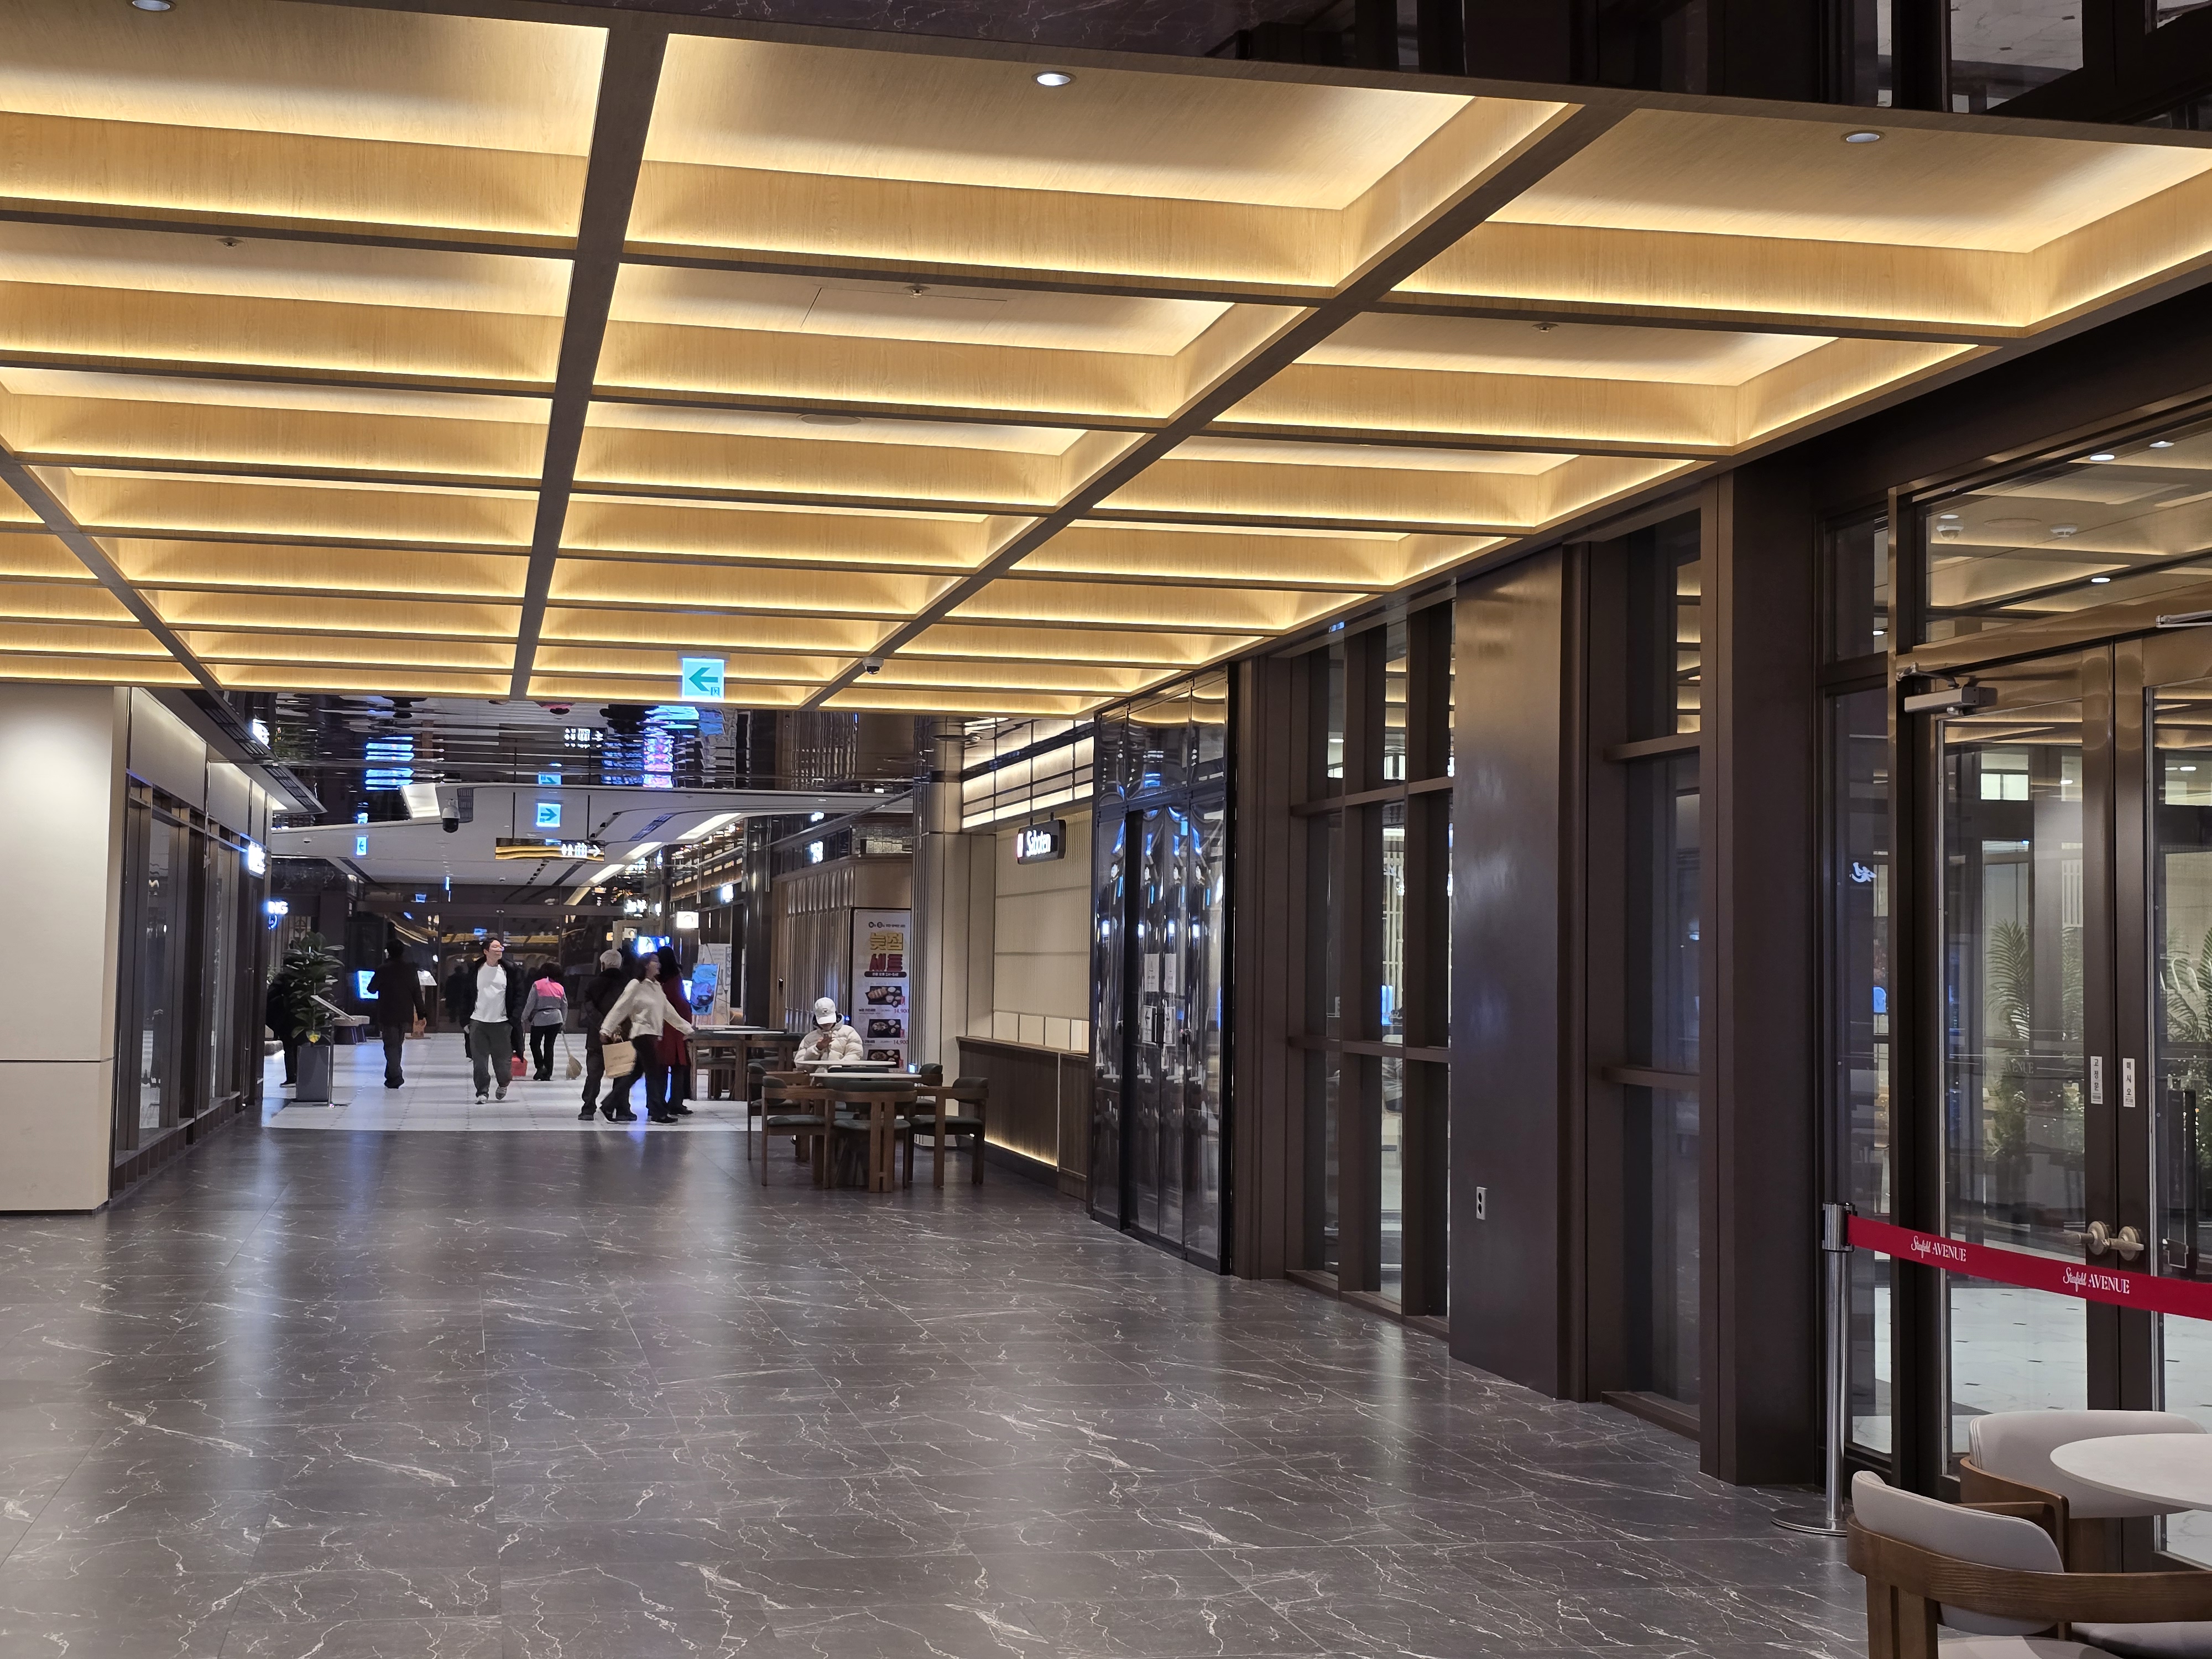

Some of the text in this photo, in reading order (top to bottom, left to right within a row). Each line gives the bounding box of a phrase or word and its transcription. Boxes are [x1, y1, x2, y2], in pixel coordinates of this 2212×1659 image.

[870, 932, 903, 950] 늦점
[869, 953, 903, 971] 세트
[1932, 1242, 1966, 1262] AVENUE
[2088, 1273, 2130, 1295] AVENUE
